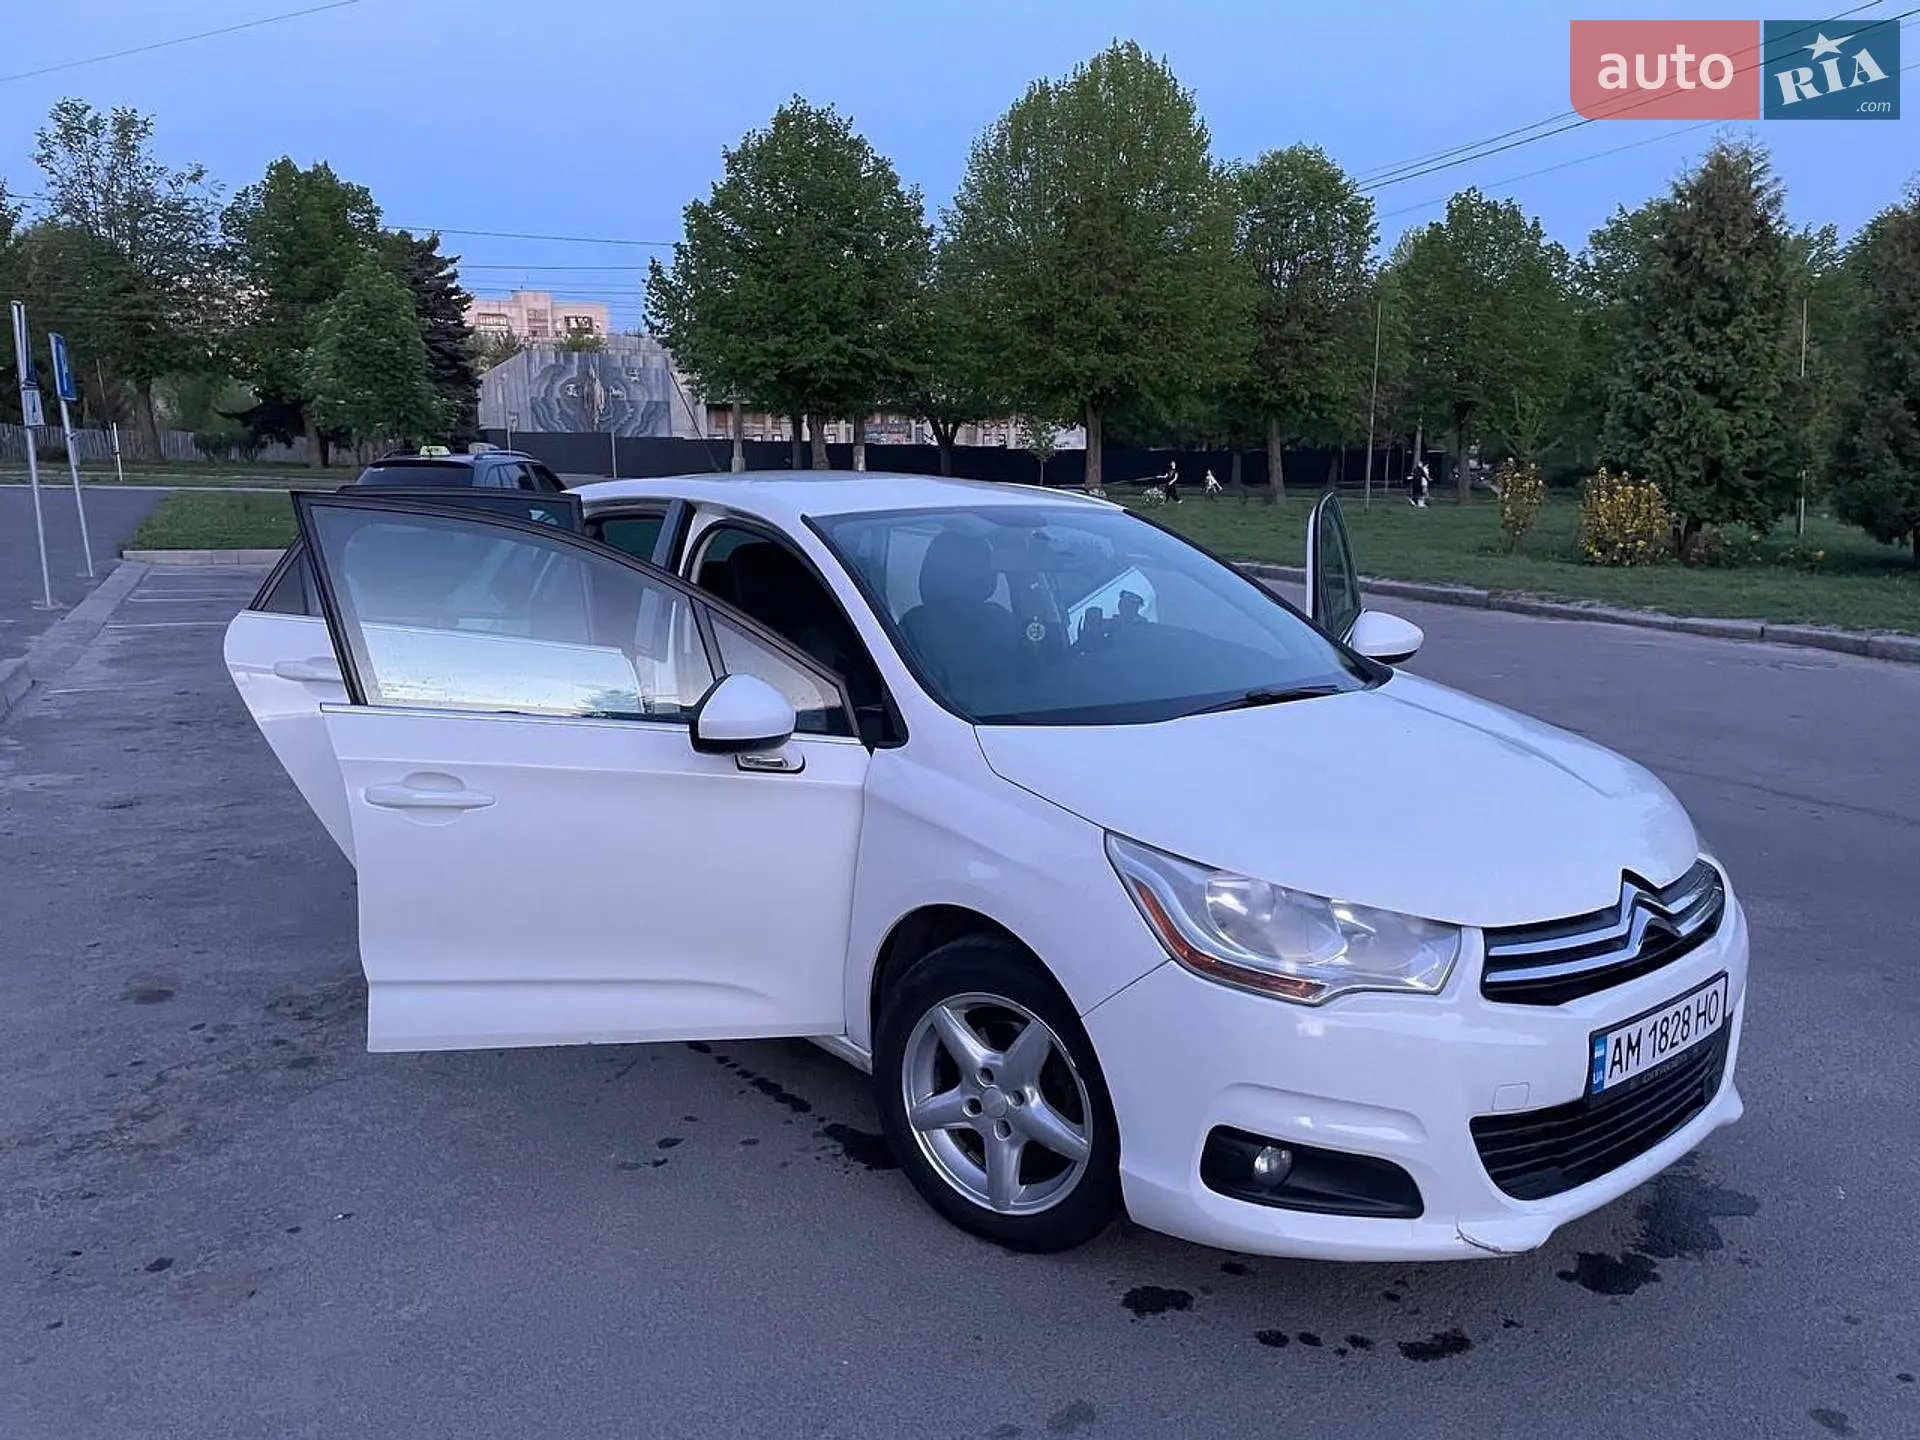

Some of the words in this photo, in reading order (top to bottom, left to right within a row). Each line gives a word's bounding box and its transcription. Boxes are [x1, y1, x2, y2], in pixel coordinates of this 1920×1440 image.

[1608, 1027, 1643, 1080] AM
[1648, 1005, 1692, 1059] 1828
[1694, 989, 1719, 1035] HO
